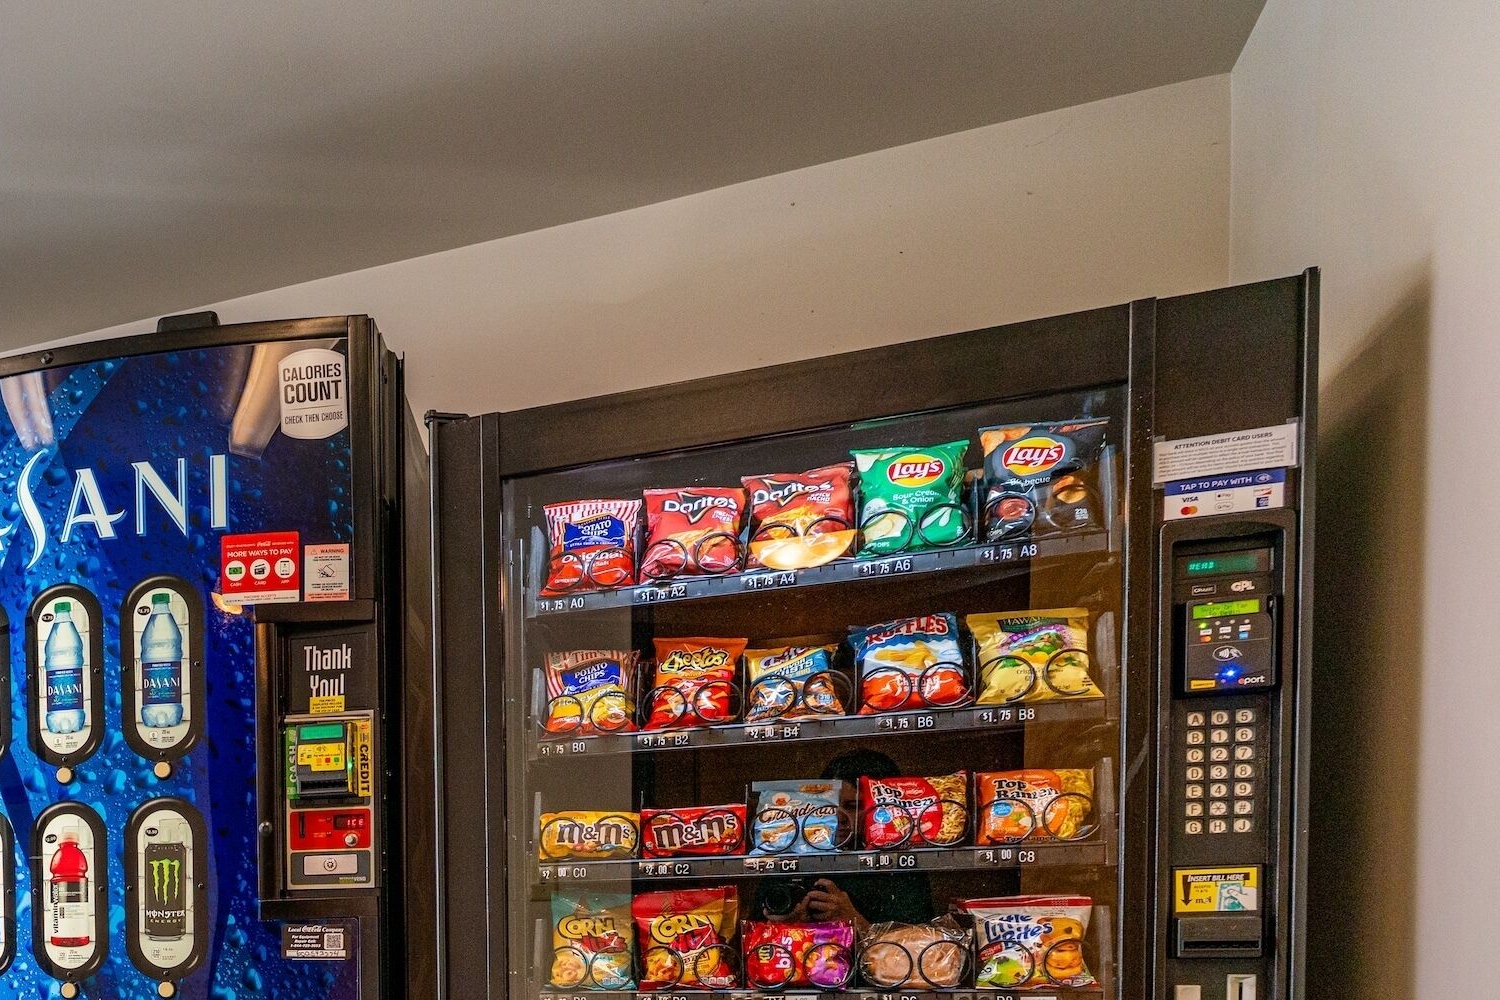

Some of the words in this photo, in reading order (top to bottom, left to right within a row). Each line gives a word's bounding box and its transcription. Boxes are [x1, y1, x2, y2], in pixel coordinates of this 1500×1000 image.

[283, 363, 341, 382] CALORIES
[284, 380, 342, 404] COUNT
[285, 415, 303, 424] CHECK
[305, 413, 320, 422] THEN
[321, 411, 343, 421] CHOOSE
[1174, 440, 1210, 450] ATTENTION
[1211, 437, 1231, 445] DEBIT
[1232, 434, 1251, 442] CARD
[1180, 483, 1197, 491] TAP
[1198, 481, 1210, 489] TO
[1211, 479, 1229, 488] PAY
[1230, 477, 1252, 485] WITH
[753, 481, 835, 505] Doritos
[893, 491, 913, 501] Sour
[664, 496, 738, 514] Doritos
[909, 496, 935, 504] Onion
[581, 528, 609, 536] CHIPS
[248, 549, 268, 557] WAYS
[984, 548, 1013, 561] $1.75
[1020, 544, 1038, 558] A8
[862, 562, 890, 575] $1.75
[894, 559, 911, 572] A6
[748, 575, 774, 588] $1.75
[780, 574, 795, 586] A4
[1231, 580, 1255, 592] GPL
[641, 588, 666, 600] $1.75
[671, 586, 686, 598] A2
[540, 600, 564, 611] $1.75
[570, 598, 584, 610] A0
[303, 643, 353, 672] Thank
[574, 662, 608, 679] POTATO
[579, 669, 606, 684] CHIPS
[48, 682, 82, 696] DASANI
[143, 676, 180, 689] DASANI
[983, 709, 1011, 722] $1.75
[1018, 708, 1035, 721] B8
[1191, 715, 1200, 725] A
[1216, 713, 1223, 723] 0
[1241, 712, 1248, 721] 5
[885, 717, 909, 729] $1.75
[918, 716, 934, 728] B6
[643, 736, 666, 747] $1.75
[674, 734, 689, 746] B2
[1191, 734, 1199, 743] B
[1217, 732, 1222, 741] 1
[542, 744, 564, 755] $1.75
[572, 742, 586, 753] B0
[1215, 749, 1223, 759] 2
[1241, 748, 1248, 758] 7
[359, 743, 370, 793] CREDIT
[873, 784, 902, 798] Top
[994, 779, 1027, 791] Top
[1215, 786, 1222, 795] 4
[996, 787, 1060, 799] Ramen
[899, 855, 915, 867] C6
[573, 867, 587, 879] C0
[675, 863, 690, 875] C2
[1187, 874, 1211, 882] INSERT
[1212, 873, 1226, 881] BILL
[146, 909, 185, 920] MONSTER
[558, 915, 616, 940] CORN
